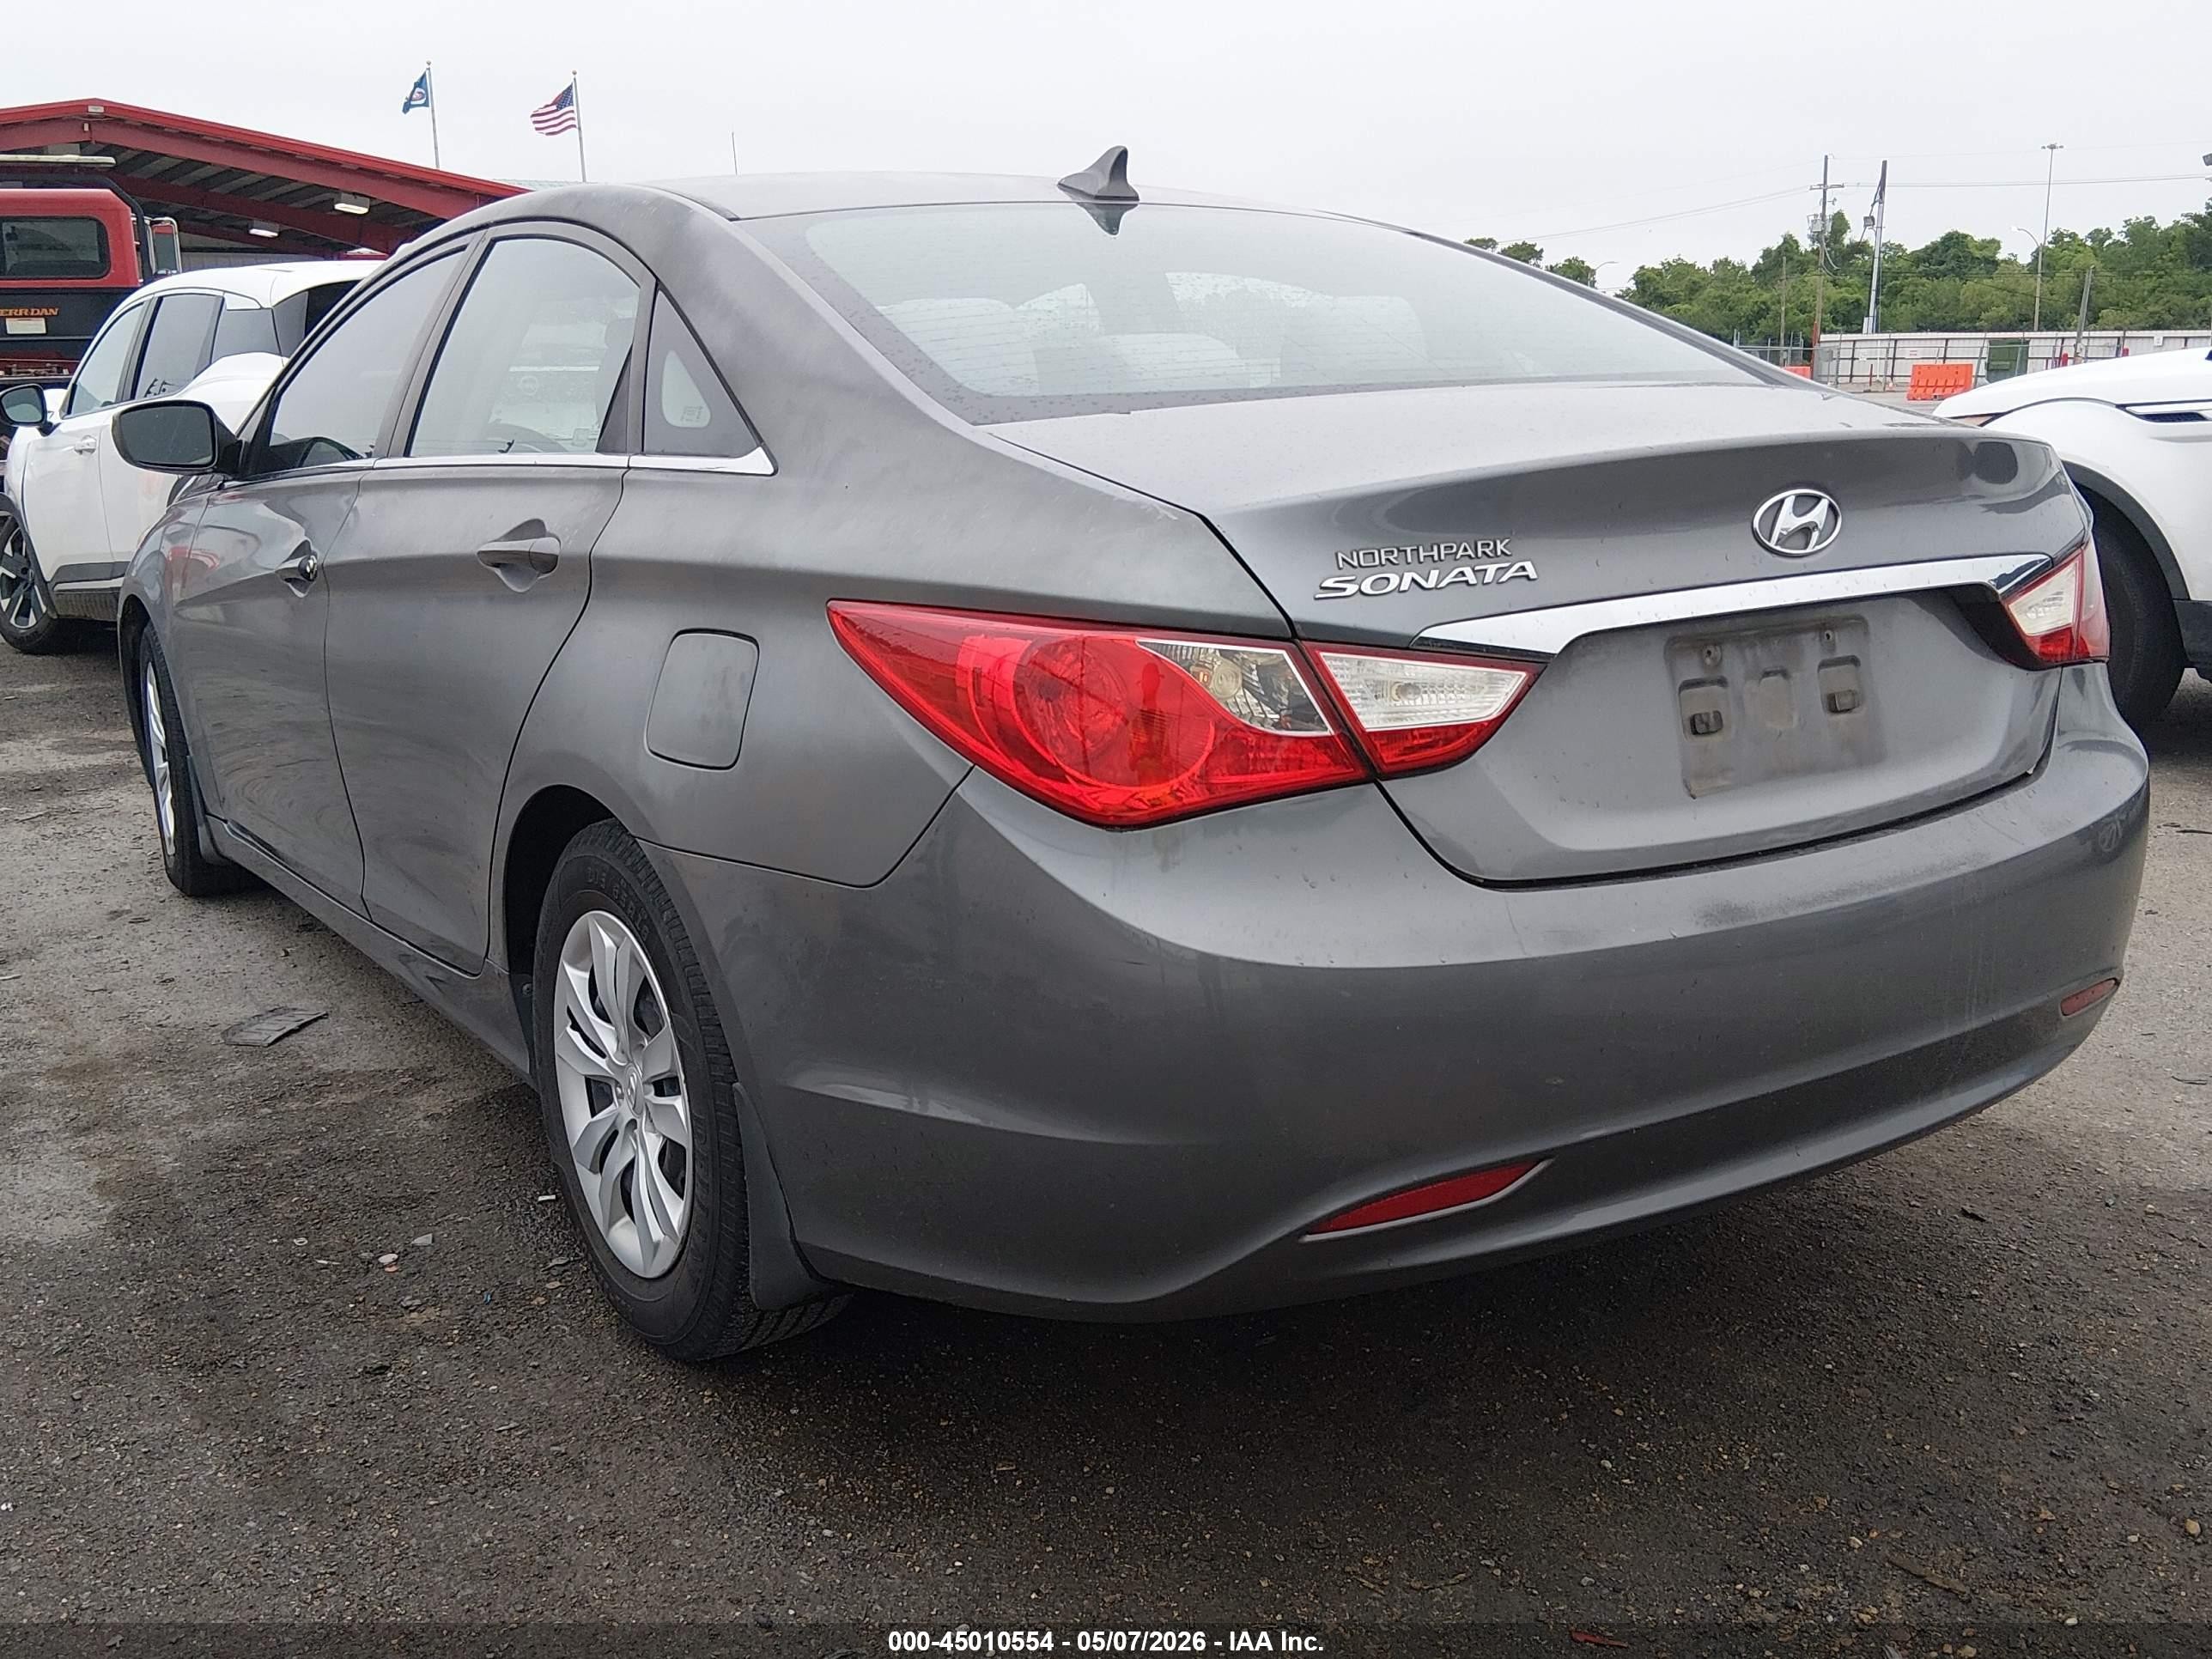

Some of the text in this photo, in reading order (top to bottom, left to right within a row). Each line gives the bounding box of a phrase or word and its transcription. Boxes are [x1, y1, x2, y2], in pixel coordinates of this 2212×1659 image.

[0, 308, 58, 317] ERR-DAN
[1336, 538, 1512, 569] NORTHPARK
[1314, 561, 1538, 599] SONATA
